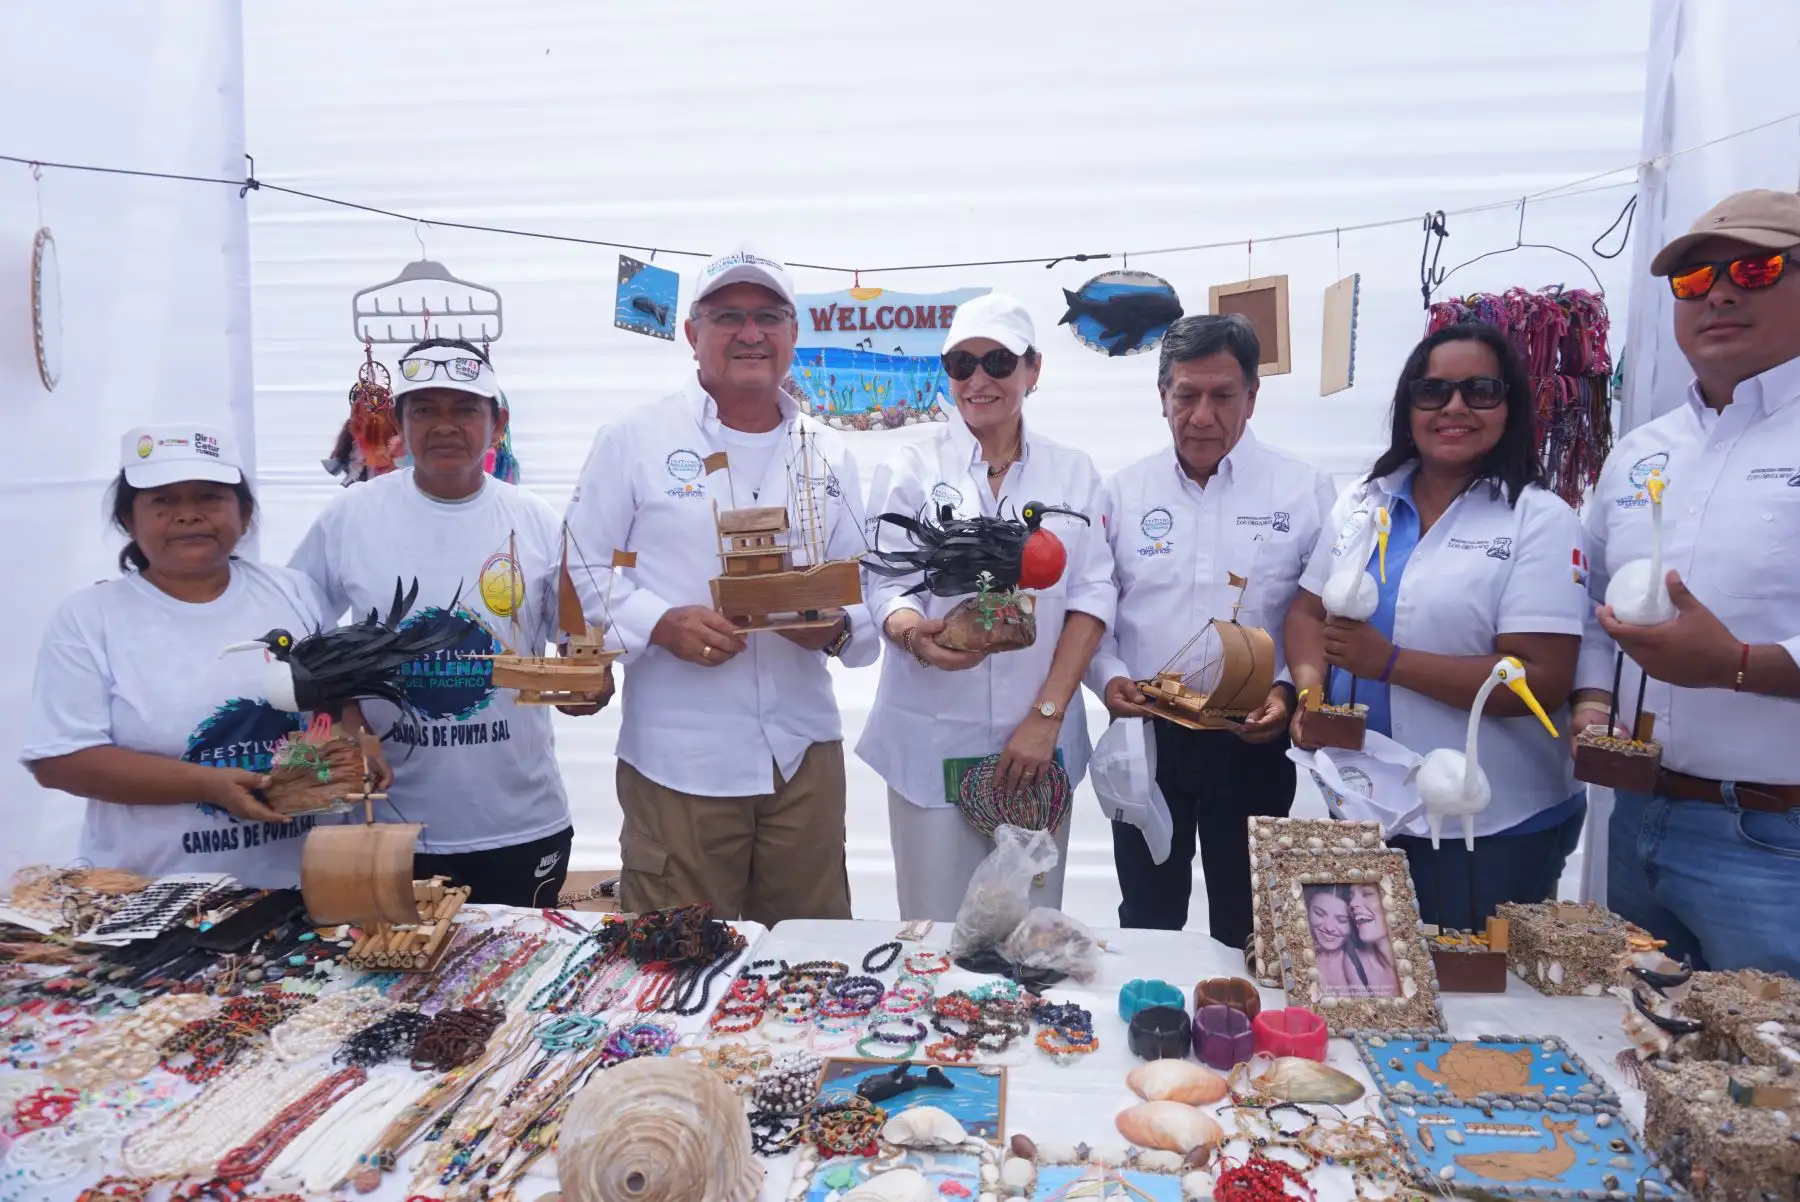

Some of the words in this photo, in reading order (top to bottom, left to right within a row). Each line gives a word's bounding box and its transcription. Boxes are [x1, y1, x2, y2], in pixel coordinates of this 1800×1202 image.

[809, 303, 957, 331] WELCOME
[195, 433, 208, 442] Dir
[432, 725, 448, 747] DE
[451, 723, 488, 747] PUNTA
[491, 719, 511, 742] SAL
[182, 827, 239, 854] CANOAS
[243, 826, 260, 849] DE
[263, 816, 300, 844] PUNTA
[539, 850, 560, 868] NIKE
